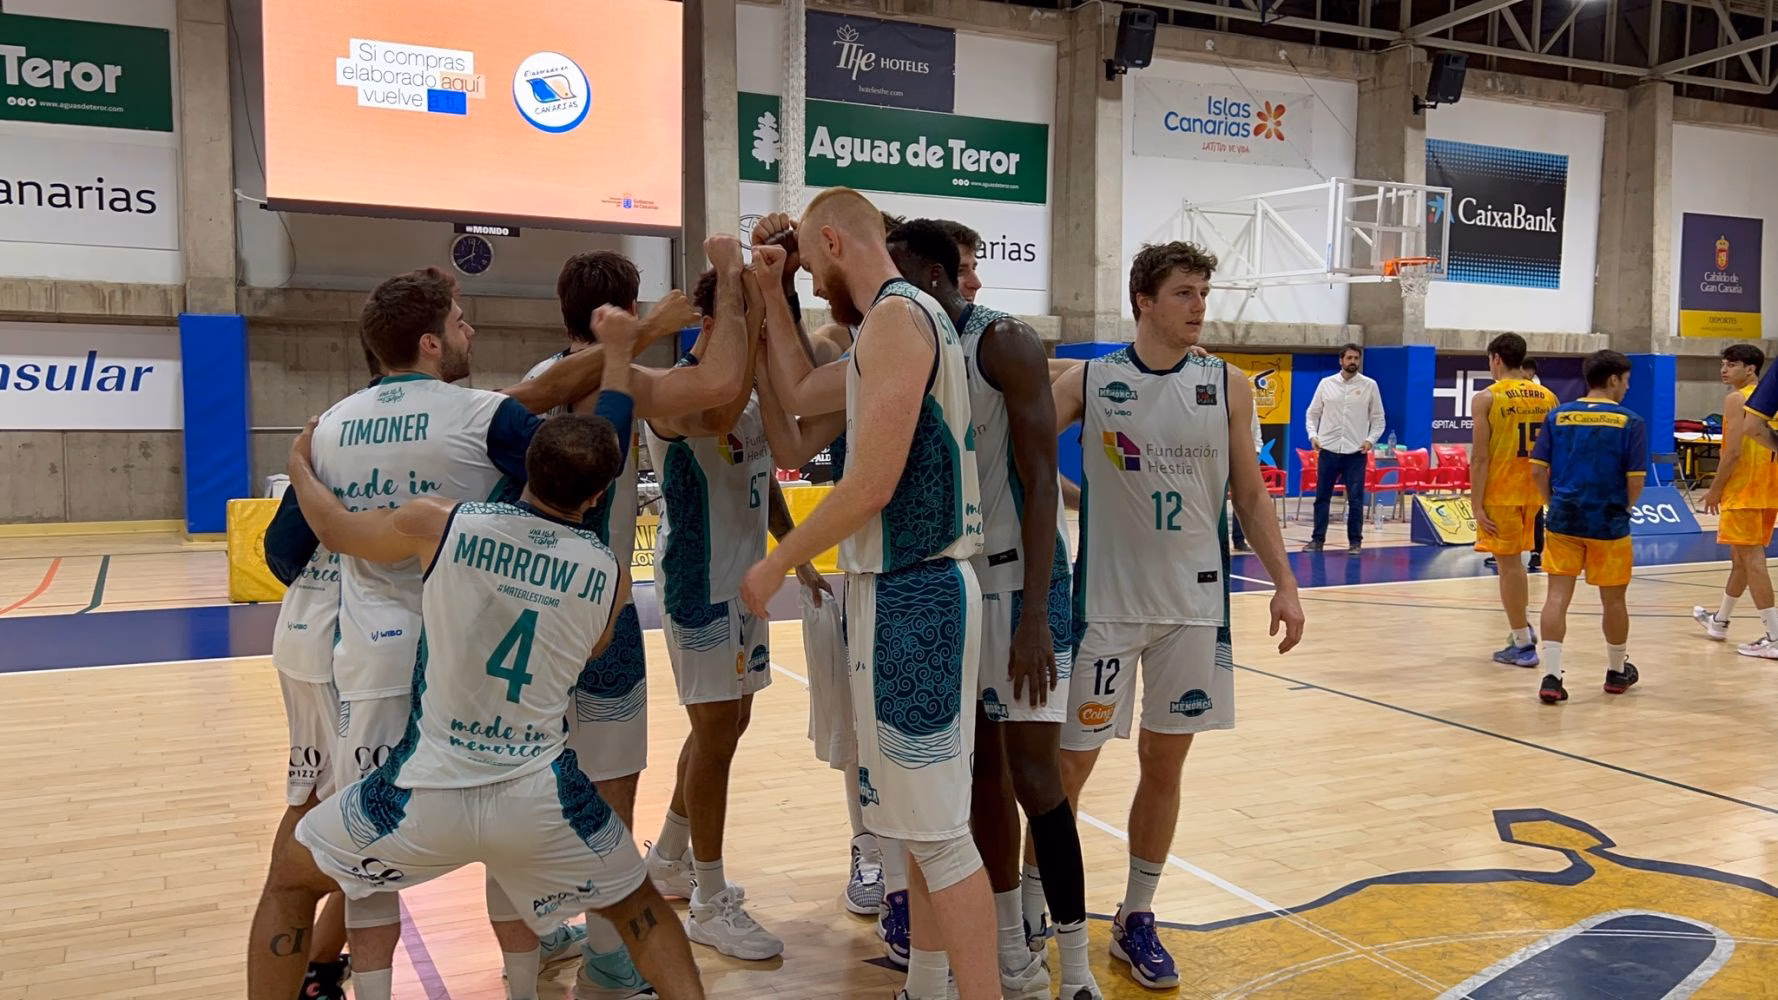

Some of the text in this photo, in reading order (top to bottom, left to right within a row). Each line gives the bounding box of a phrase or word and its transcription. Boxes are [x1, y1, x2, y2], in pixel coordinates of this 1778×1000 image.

[0, 44, 122, 93] Teror
[359, 42, 465, 71] Si compras
[880, 57, 930, 74] HOTELES
[342, 64, 480, 94] elaborado aquí
[39, 100, 124, 113] www.aguasdeteror.com
[363, 88, 423, 107] vuelve
[535, 101, 578, 114] CANARIAS
[1208, 95, 1250, 119] Islas
[1164, 111, 1250, 138] Canarias
[809, 126, 1020, 174] Aguas de Teror
[1458, 197, 1557, 233] CaixaBank
[1700, 281, 1743, 294] Gran Canaria
[1704, 271, 1740, 283] Cabildo de
[338, 412, 430, 447] TIMONER
[1146, 444, 1218, 459] Fundación
[1147, 460, 1194, 476] Hestia
[409, 470, 442, 495] in
[1151, 490, 1183, 531] 12
[453, 532, 579, 593] MARROW
[577, 567, 608, 605] JR
[380, 629, 403, 638] WIBO
[486, 608, 539, 704] 4
[1093, 658, 1120, 695] 12
[451, 715, 551, 742] made in
